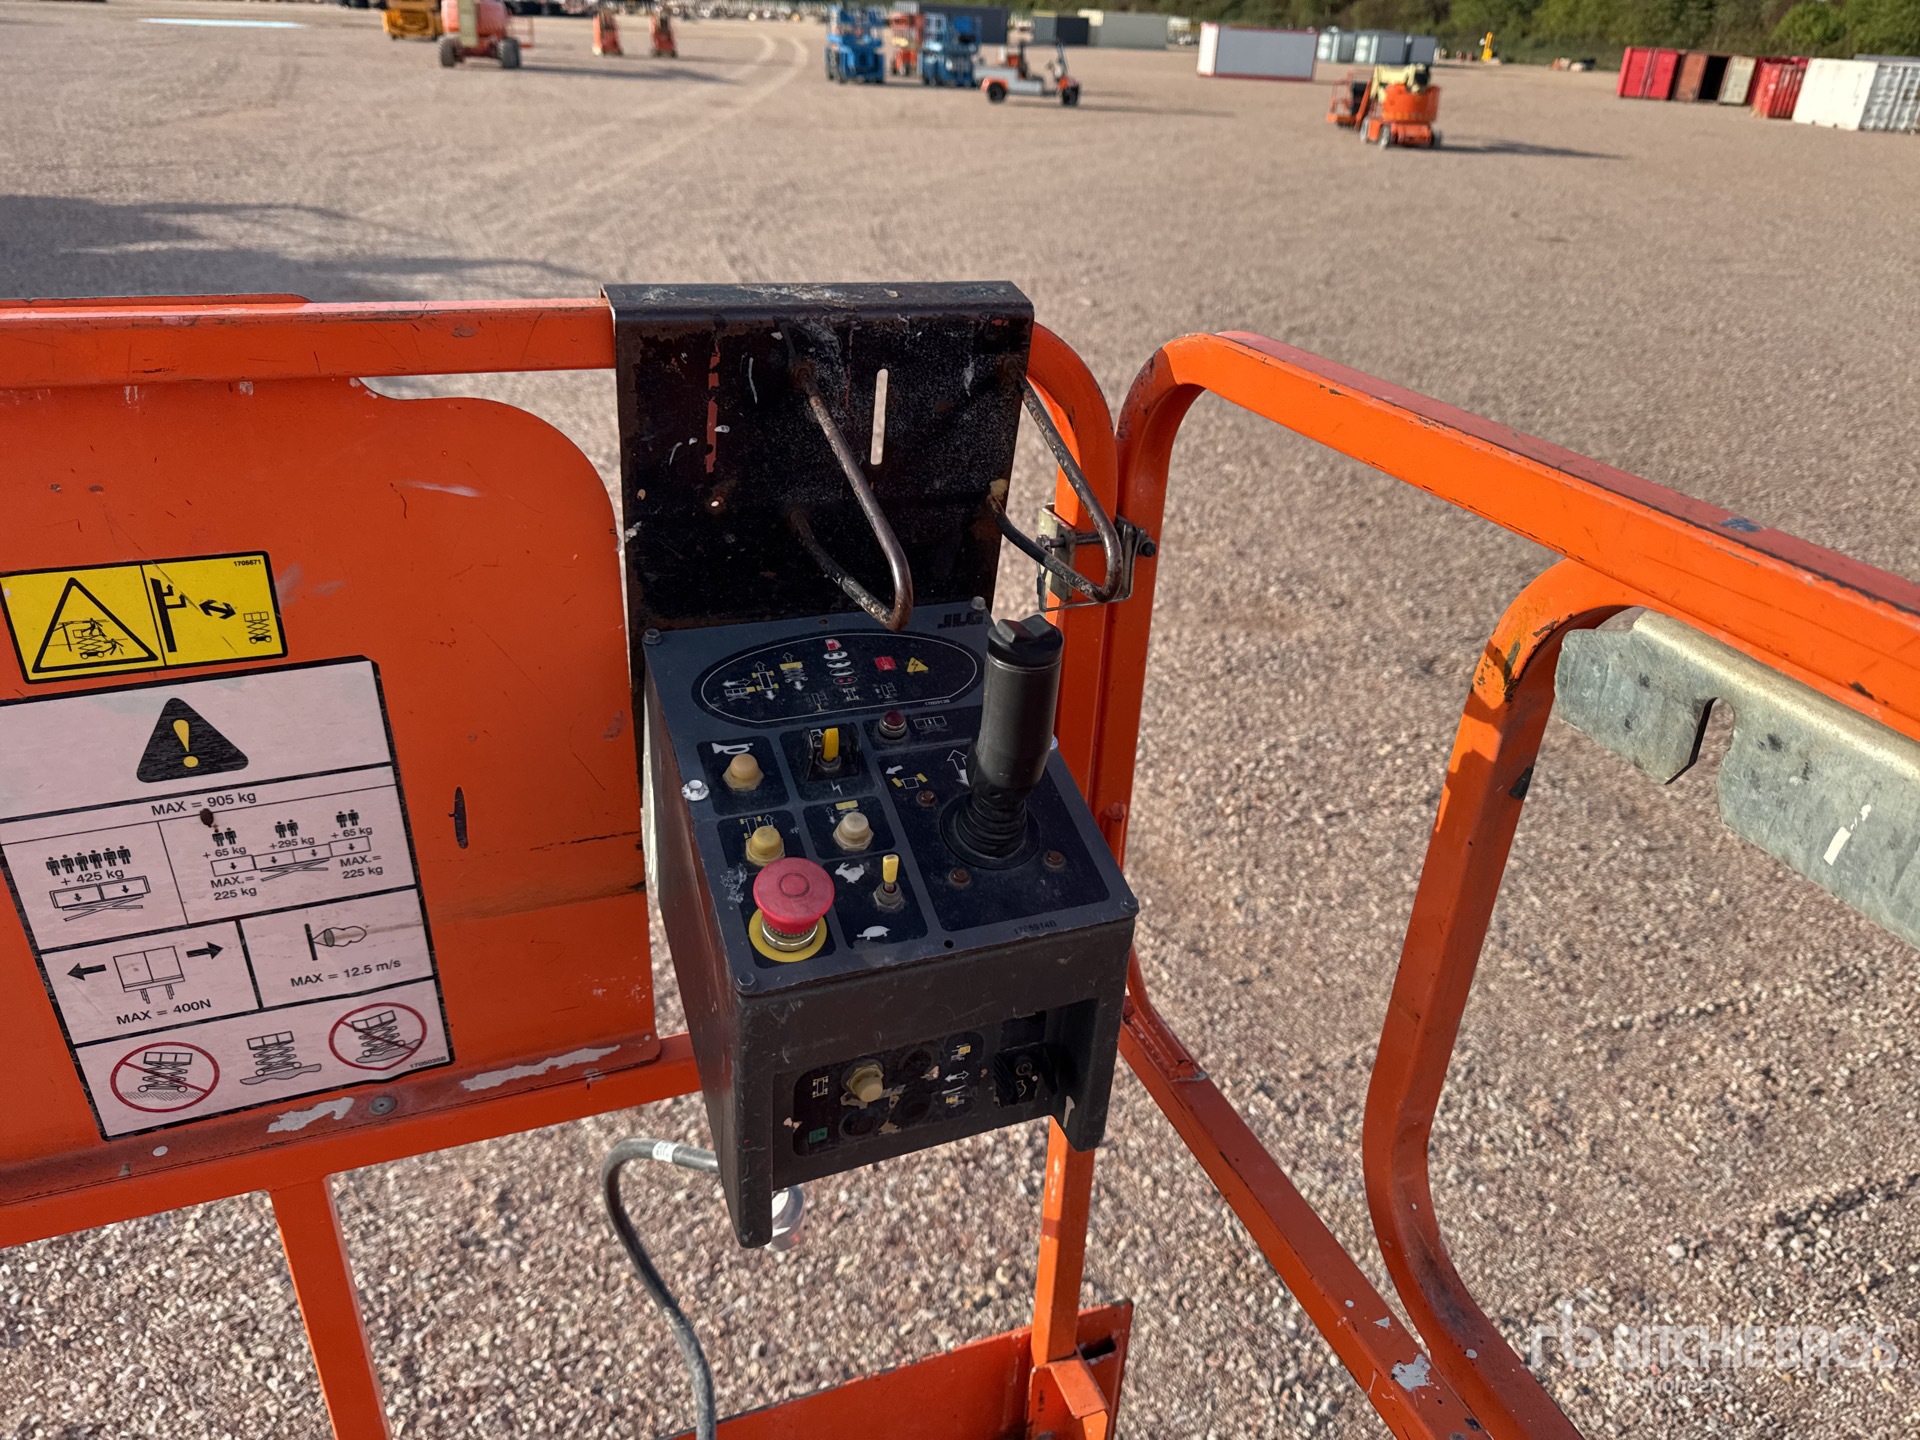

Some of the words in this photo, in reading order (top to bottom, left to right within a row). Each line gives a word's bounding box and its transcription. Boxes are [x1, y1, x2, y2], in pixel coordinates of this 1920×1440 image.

[937, 611, 984, 629] JLG
[151, 801, 187, 816] MAX
[207, 794, 234, 807] 905
[237, 792, 257, 804] kg
[342, 828, 357, 838] 65
[359, 826, 373, 835] kg
[301, 837, 315, 846] kg
[214, 848, 230, 857] 65
[232, 846, 247, 855] kg
[76, 871, 103, 883] 425
[105, 869, 124, 879] kg
[342, 868, 365, 879] 225
[368, 866, 384, 875] kg
[213, 889, 238, 900] 225
[240, 887, 257, 897] kg
[290, 973, 324, 987] MAX
[343, 964, 373, 978] 12.5
[376, 959, 401, 971] m/s
[116, 1010, 152, 1025] MAX
[173, 998, 212, 1014] 400N
